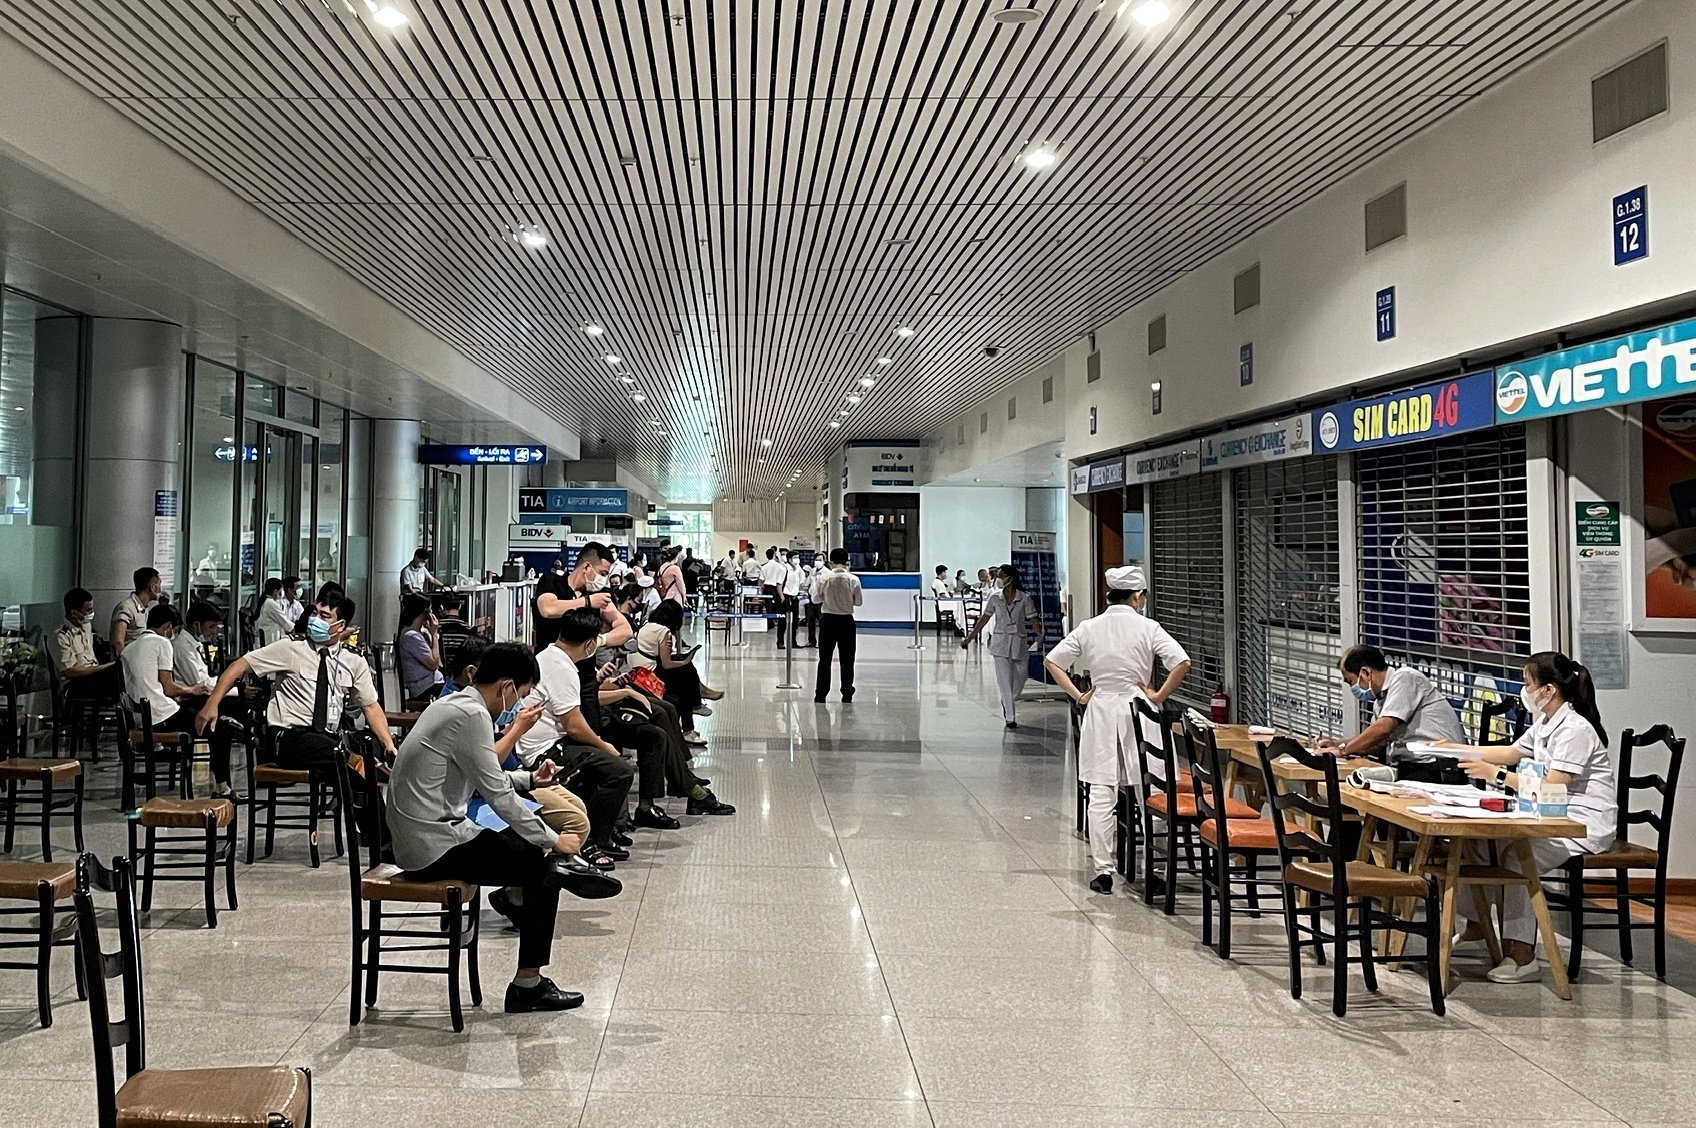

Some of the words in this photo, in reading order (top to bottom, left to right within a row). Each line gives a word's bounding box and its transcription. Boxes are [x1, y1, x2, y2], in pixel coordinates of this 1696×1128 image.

[1616, 197, 1641, 217] G.1.38
[1620, 222, 1639, 253] 12
[1380, 311, 1390, 333] 11
[1353, 403, 1384, 443] SIM
[1387, 393, 1432, 438] CARD
[1434, 383, 1459, 428] 4G
[500, 448, 511, 456] RA
[521, 495, 544, 508] TIA
[567, 497, 589, 506] AIRPORT
[521, 528, 543, 537] BIDV
[1018, 535, 1034, 545] TIA
[1579, 548, 1595, 558] 4G
